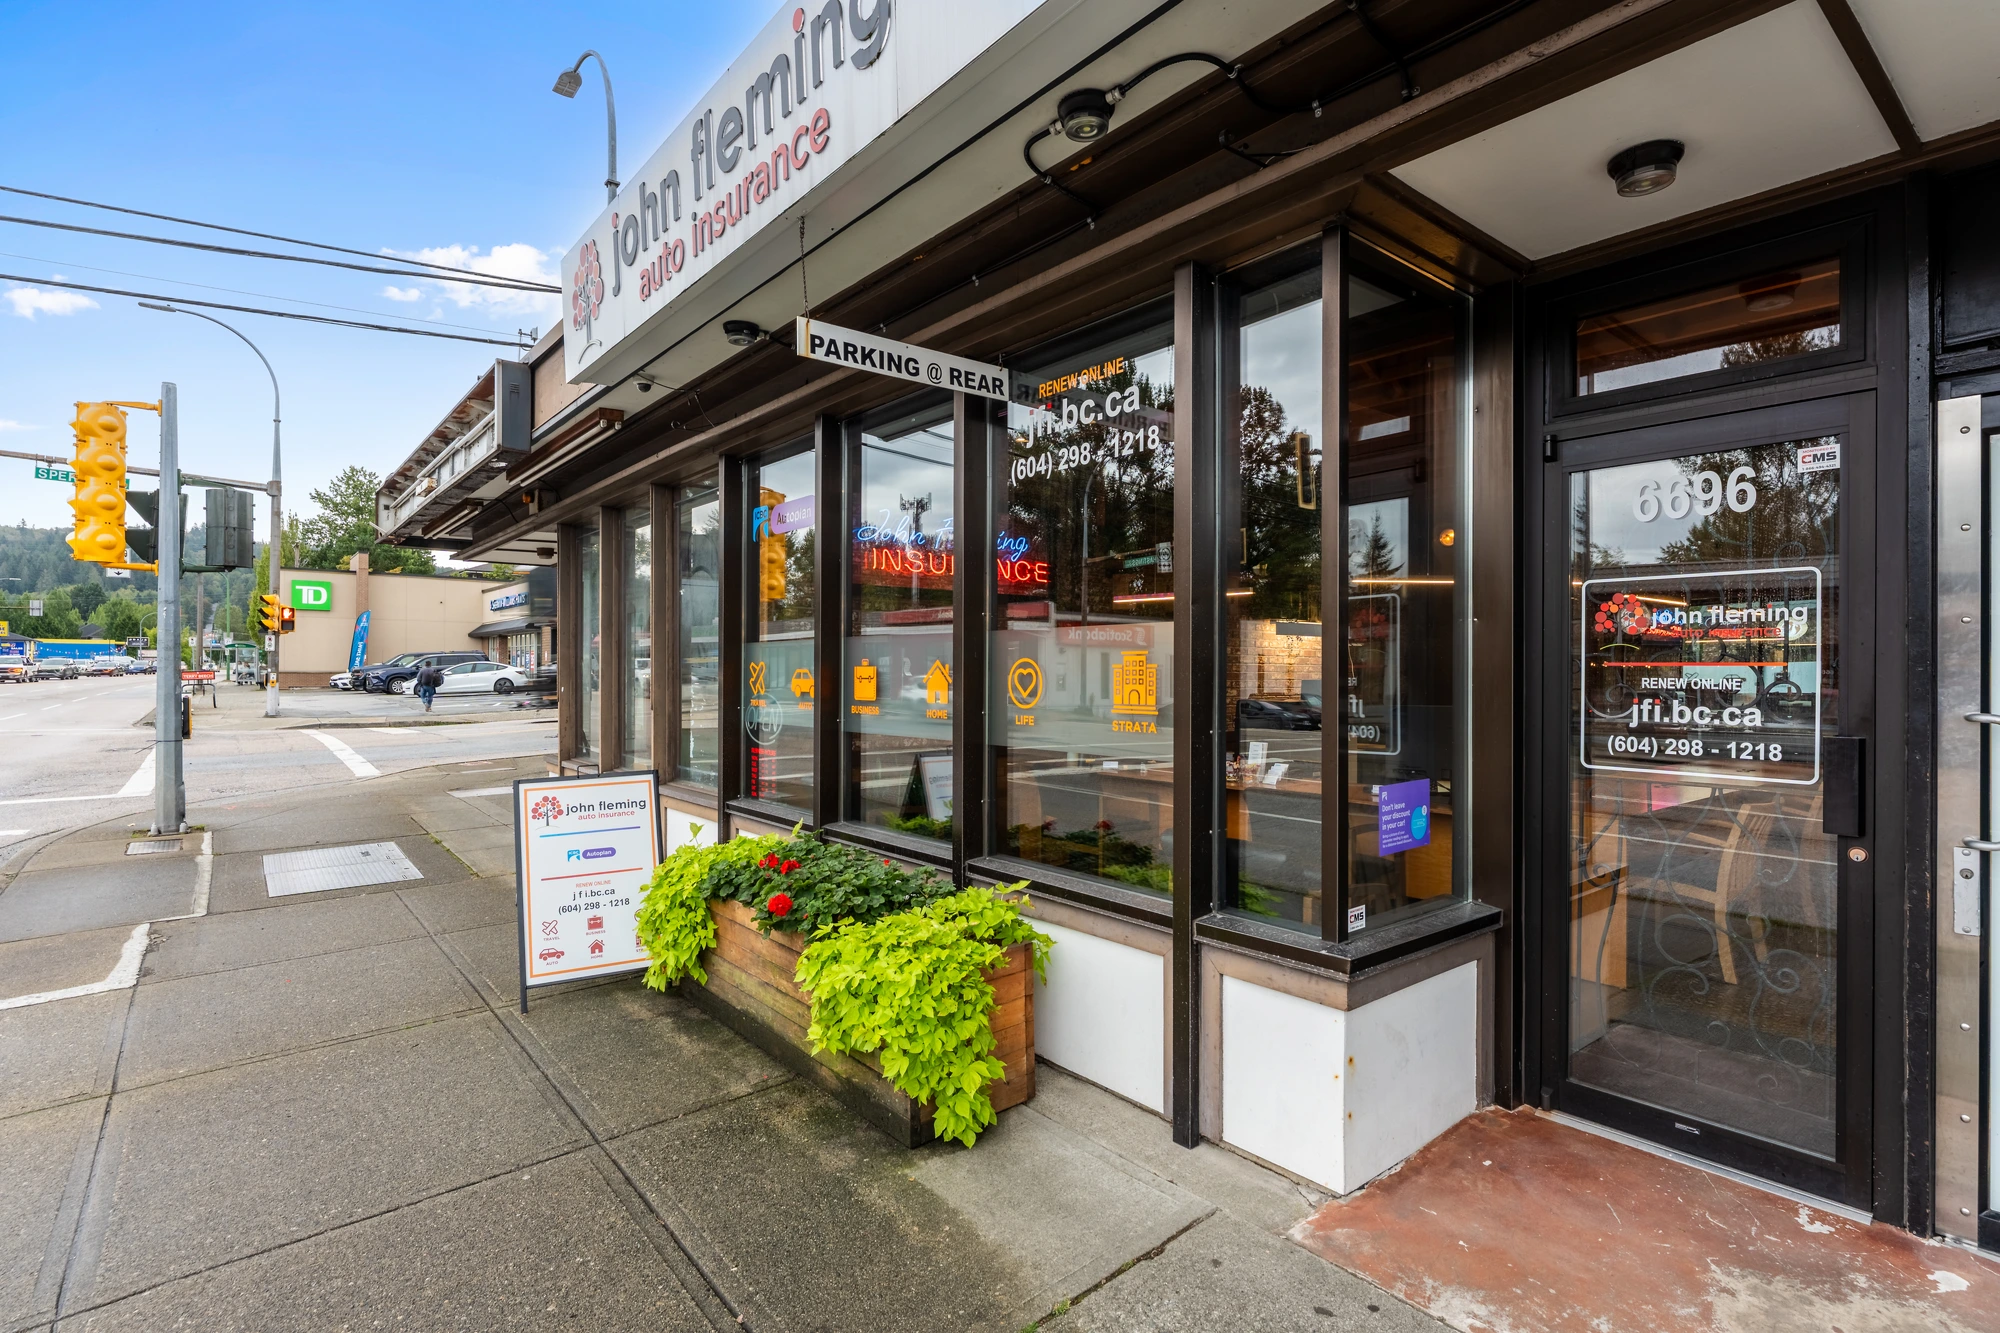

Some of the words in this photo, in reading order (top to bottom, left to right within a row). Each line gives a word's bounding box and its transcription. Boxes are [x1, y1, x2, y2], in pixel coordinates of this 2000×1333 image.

[612, 169, 681, 297] john
[691, 0, 892, 201] fleming
[639, 238, 684, 301] auto
[691, 107, 830, 257] insurance
[809, 333, 920, 377] PARKING
[926, 362, 942, 384] @
[949, 367, 1005, 396] REAR
[1038, 374, 1078, 398] RENEW
[1080, 357, 1124, 384] ONLINE
[1025, 385, 1140, 448] jfi.bc.ca
[1011, 450, 1052, 486] (604)
[1058, 442, 1091, 470] 298
[1109, 425, 1160, 457] 1218
[1801, 451, 1837, 464] CMS
[1632, 466, 1757, 523] 6696
[776, 507, 812, 525] Autoplan
[853, 508, 925, 545] John
[295, 585, 327, 604] TD
[1650, 607, 1701, 629] john
[1711, 603, 1808, 623] fleming
[1671, 627, 1704, 638] auto
[1641, 678, 1687, 690] RENEW
[1690, 678, 1742, 691] ONLINE
[851, 705, 879, 715] BUSINESS
[926, 709, 948, 719] HOME
[1629, 697, 1762, 728] jfi.bc.ca
[1015, 715, 1035, 726] LIFE
[1112, 720, 1157, 734] STRATA
[1607, 735, 1658, 757] (604)
[1665, 738, 1704, 756] 298
[1726, 742, 1782, 762] 1218
[566, 803, 595, 816] john
[599, 799, 646, 811] fleming
[598, 810, 635, 819] insurance
[586, 849, 612, 858] Autoplan
[558, 904, 581, 915] (604)
[584, 902, 600, 911] 298
[609, 898, 630, 907] 1218
[1350, 911, 1364, 923] CMS
